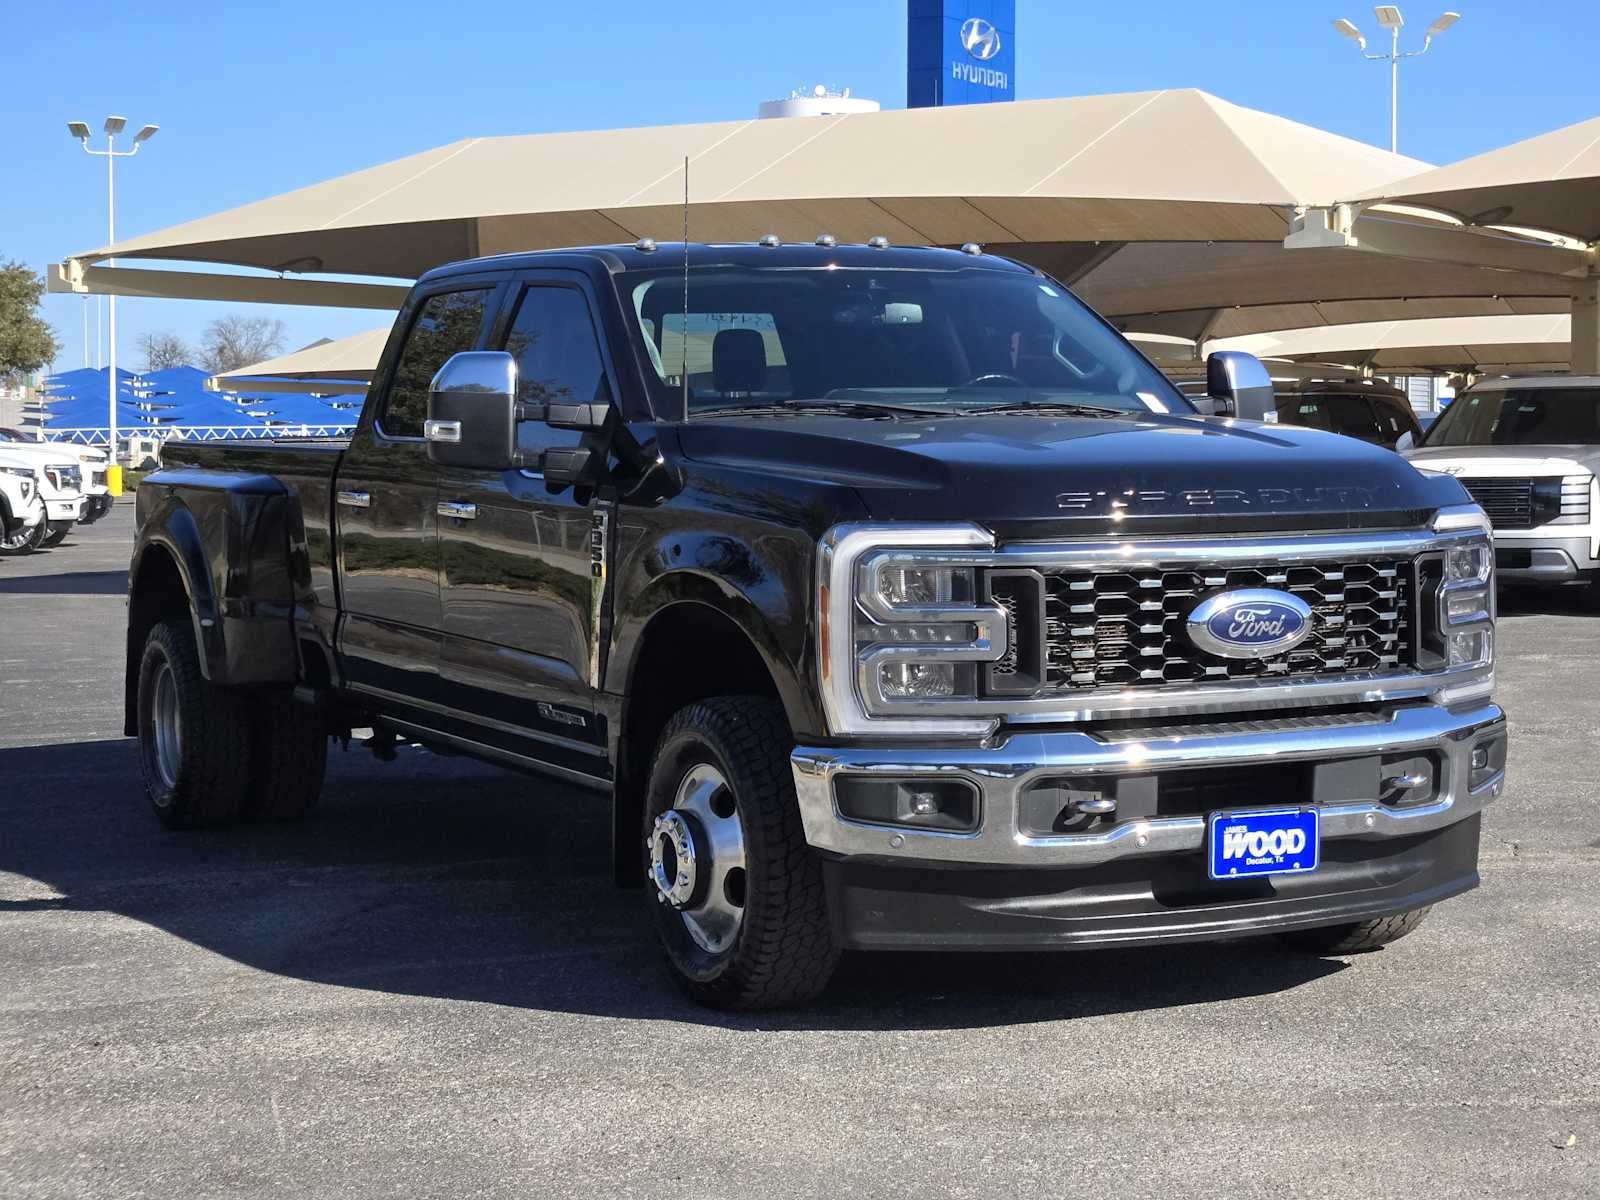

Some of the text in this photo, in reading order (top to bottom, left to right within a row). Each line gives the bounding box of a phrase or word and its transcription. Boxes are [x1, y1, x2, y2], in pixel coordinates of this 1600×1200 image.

[952, 61, 1008, 90] HYUNDAI
[1228, 608, 1286, 638] Ford
[1223, 828, 1306, 860] WOOD
